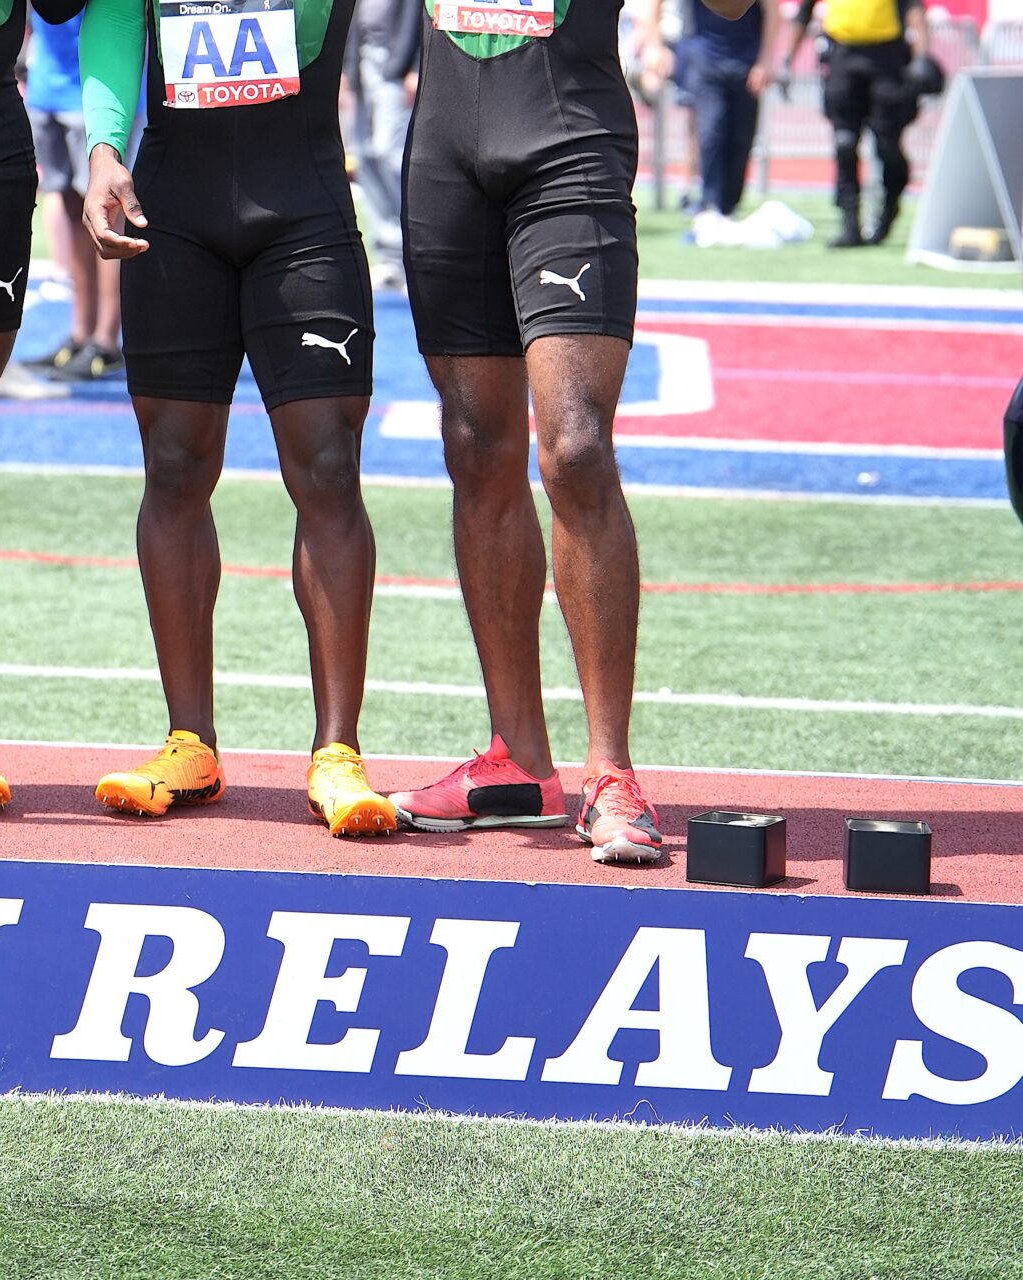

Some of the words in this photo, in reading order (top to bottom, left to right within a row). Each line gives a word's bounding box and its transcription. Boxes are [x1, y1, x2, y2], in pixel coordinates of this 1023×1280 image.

[179, 4, 212, 15] Dream
[212, 2, 232, 14] On.
[460, 10, 540, 32] TOYOTA
[181, 17, 279, 79] AA
[201, 83, 286, 104] TOYOTA
[49, 901, 1023, 1107] RELAYS
